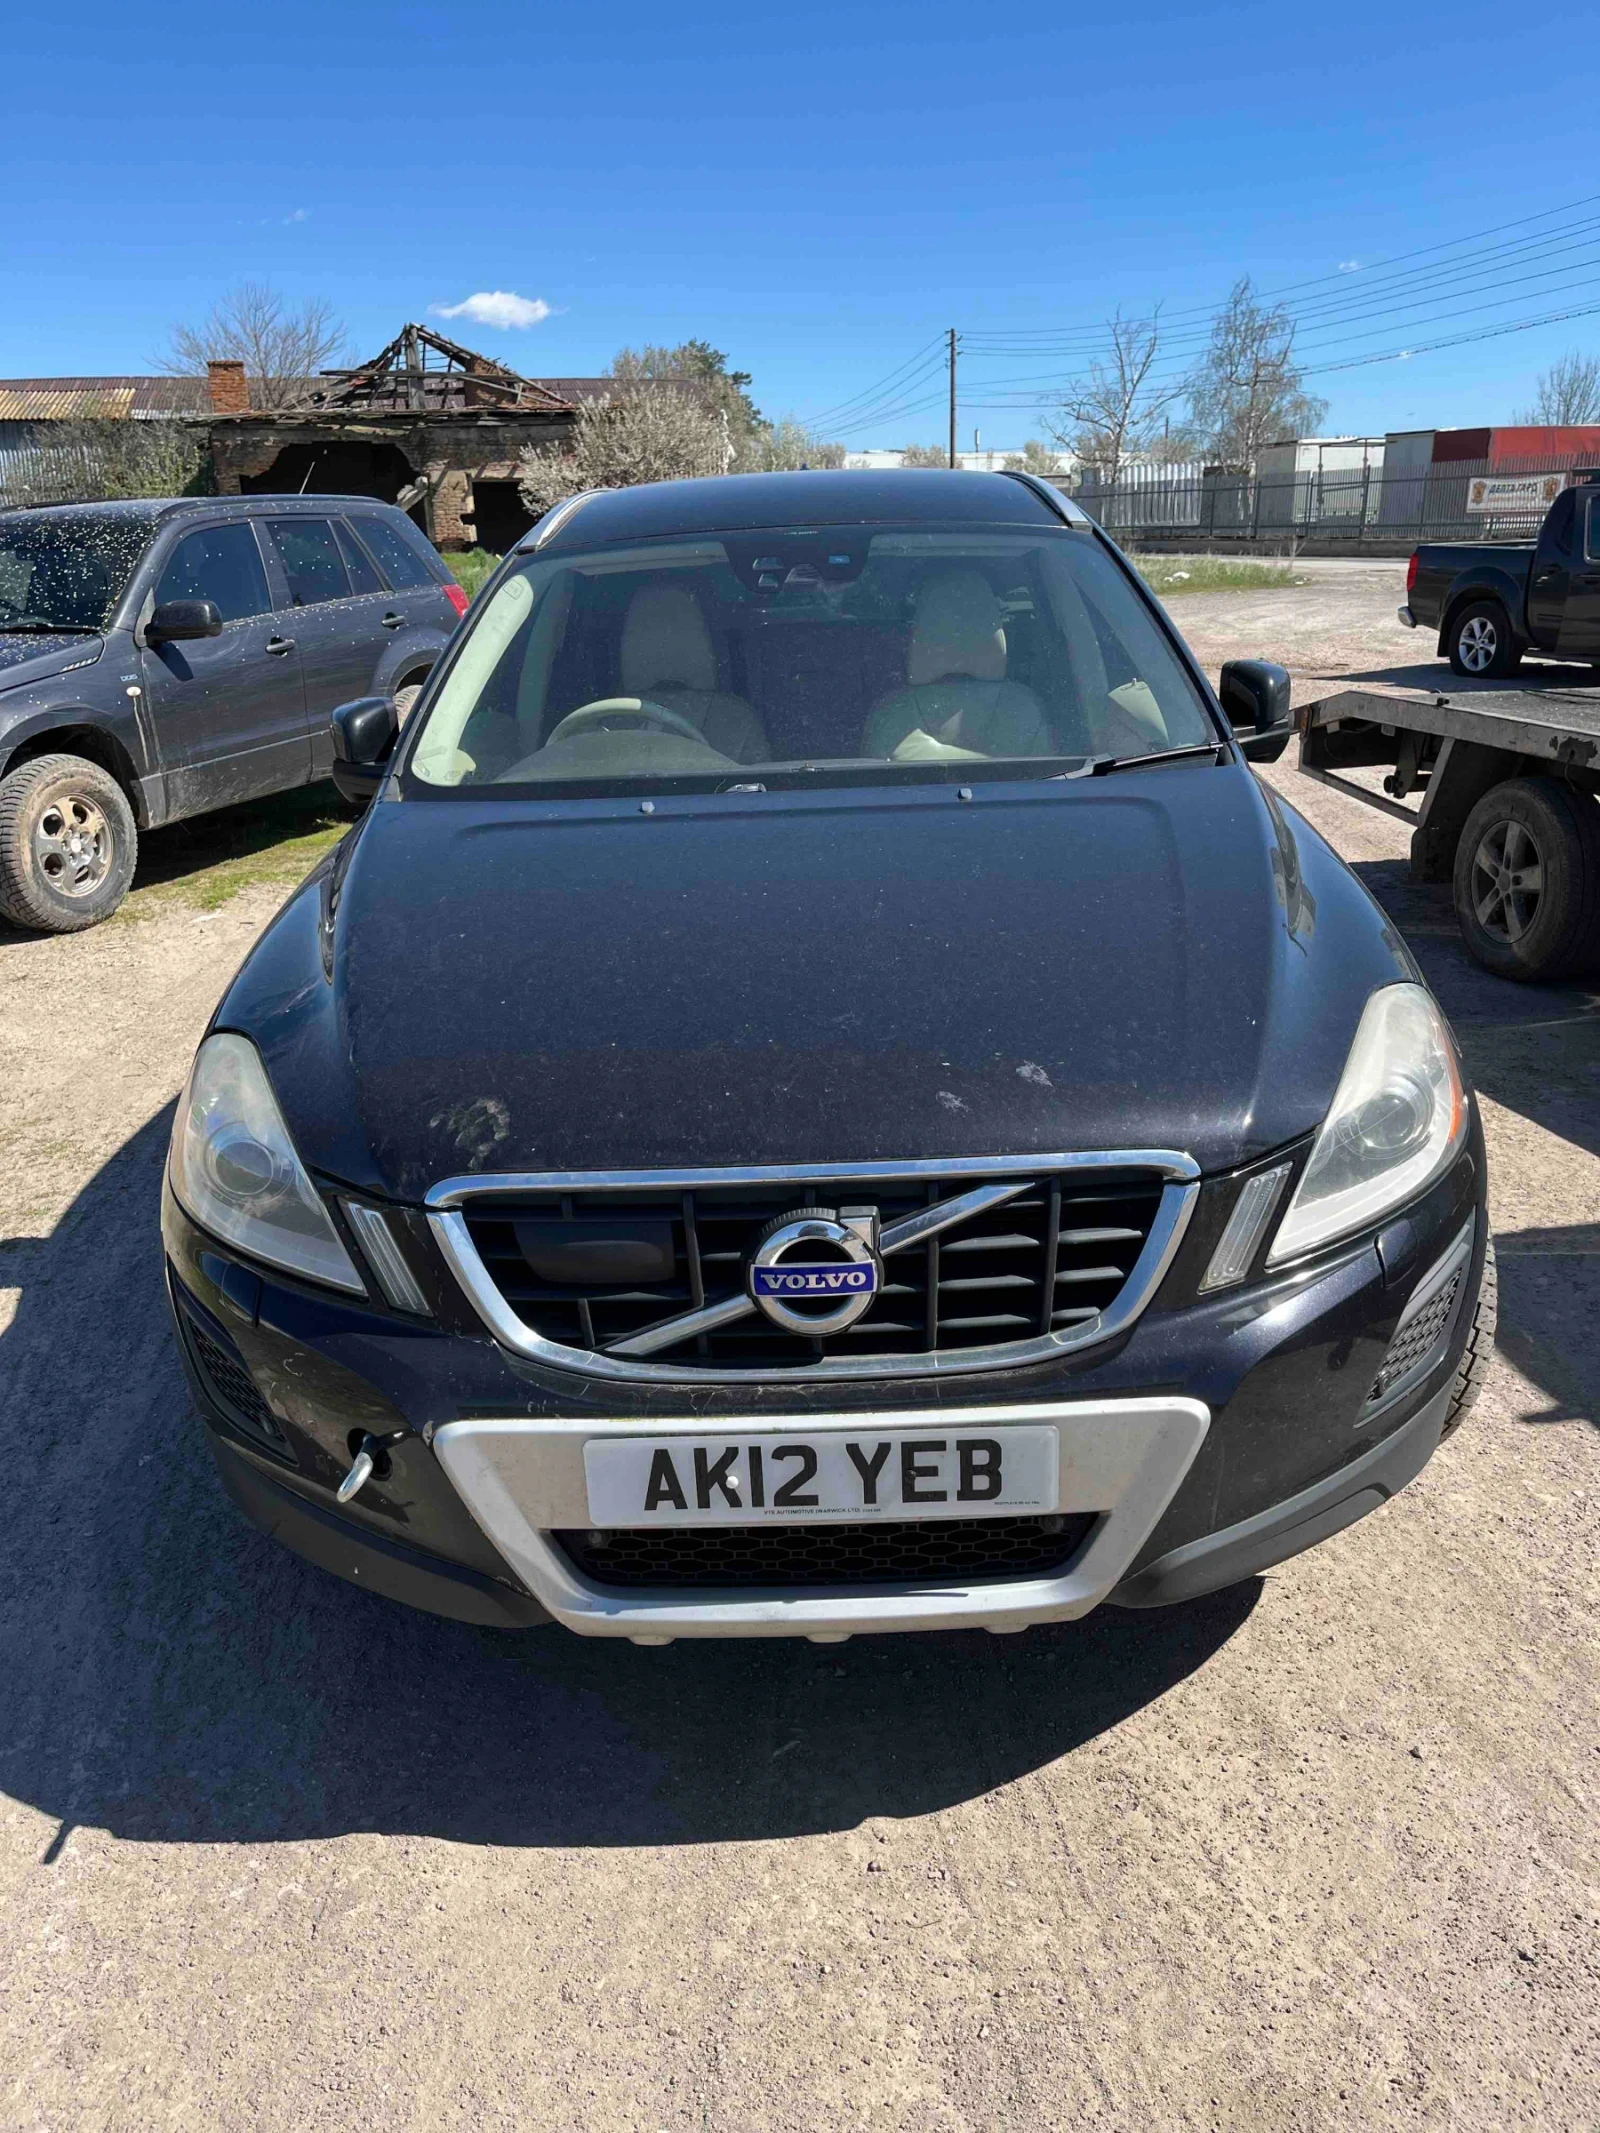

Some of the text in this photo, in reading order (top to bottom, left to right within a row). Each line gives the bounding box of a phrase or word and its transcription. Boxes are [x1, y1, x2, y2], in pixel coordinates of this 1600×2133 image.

[760, 1271, 867, 1289] VOLVO
[644, 1438, 1003, 1511] AK12 YEB
